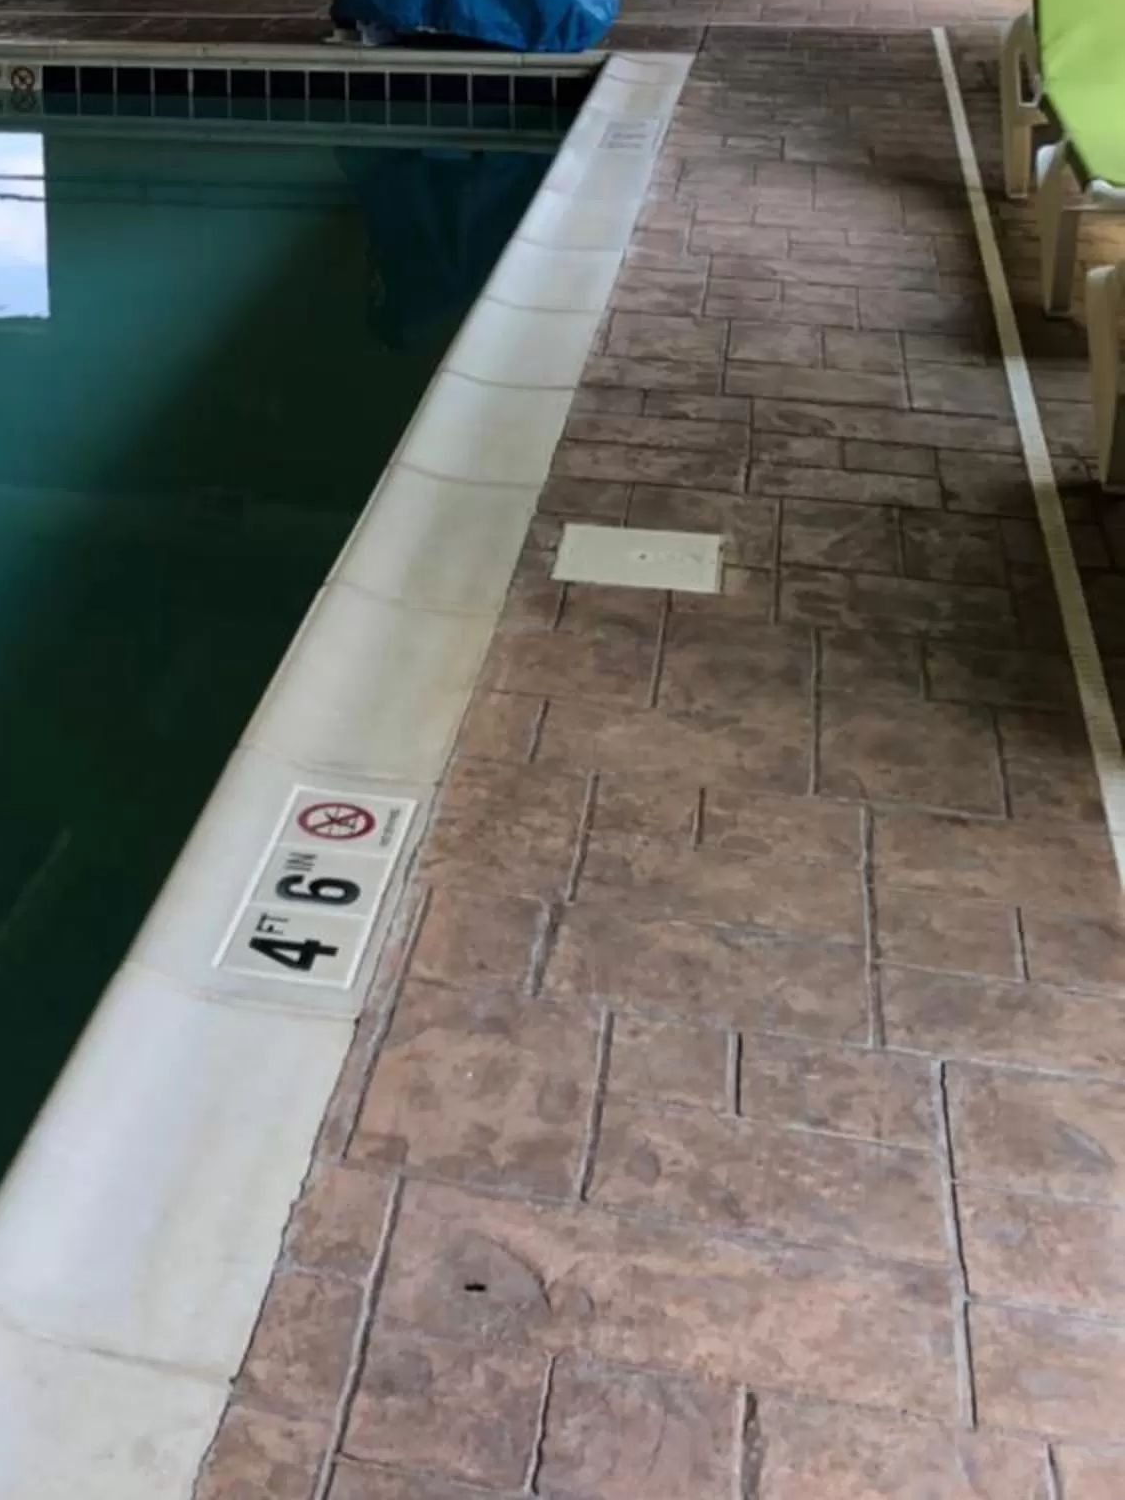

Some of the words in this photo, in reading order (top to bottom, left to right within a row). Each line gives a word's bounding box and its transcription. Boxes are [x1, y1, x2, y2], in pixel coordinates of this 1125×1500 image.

[283, 852, 318, 872] IN
[276, 874, 361, 906] 6
[254, 912, 290, 935] FT
[248, 936, 339, 972] 4
